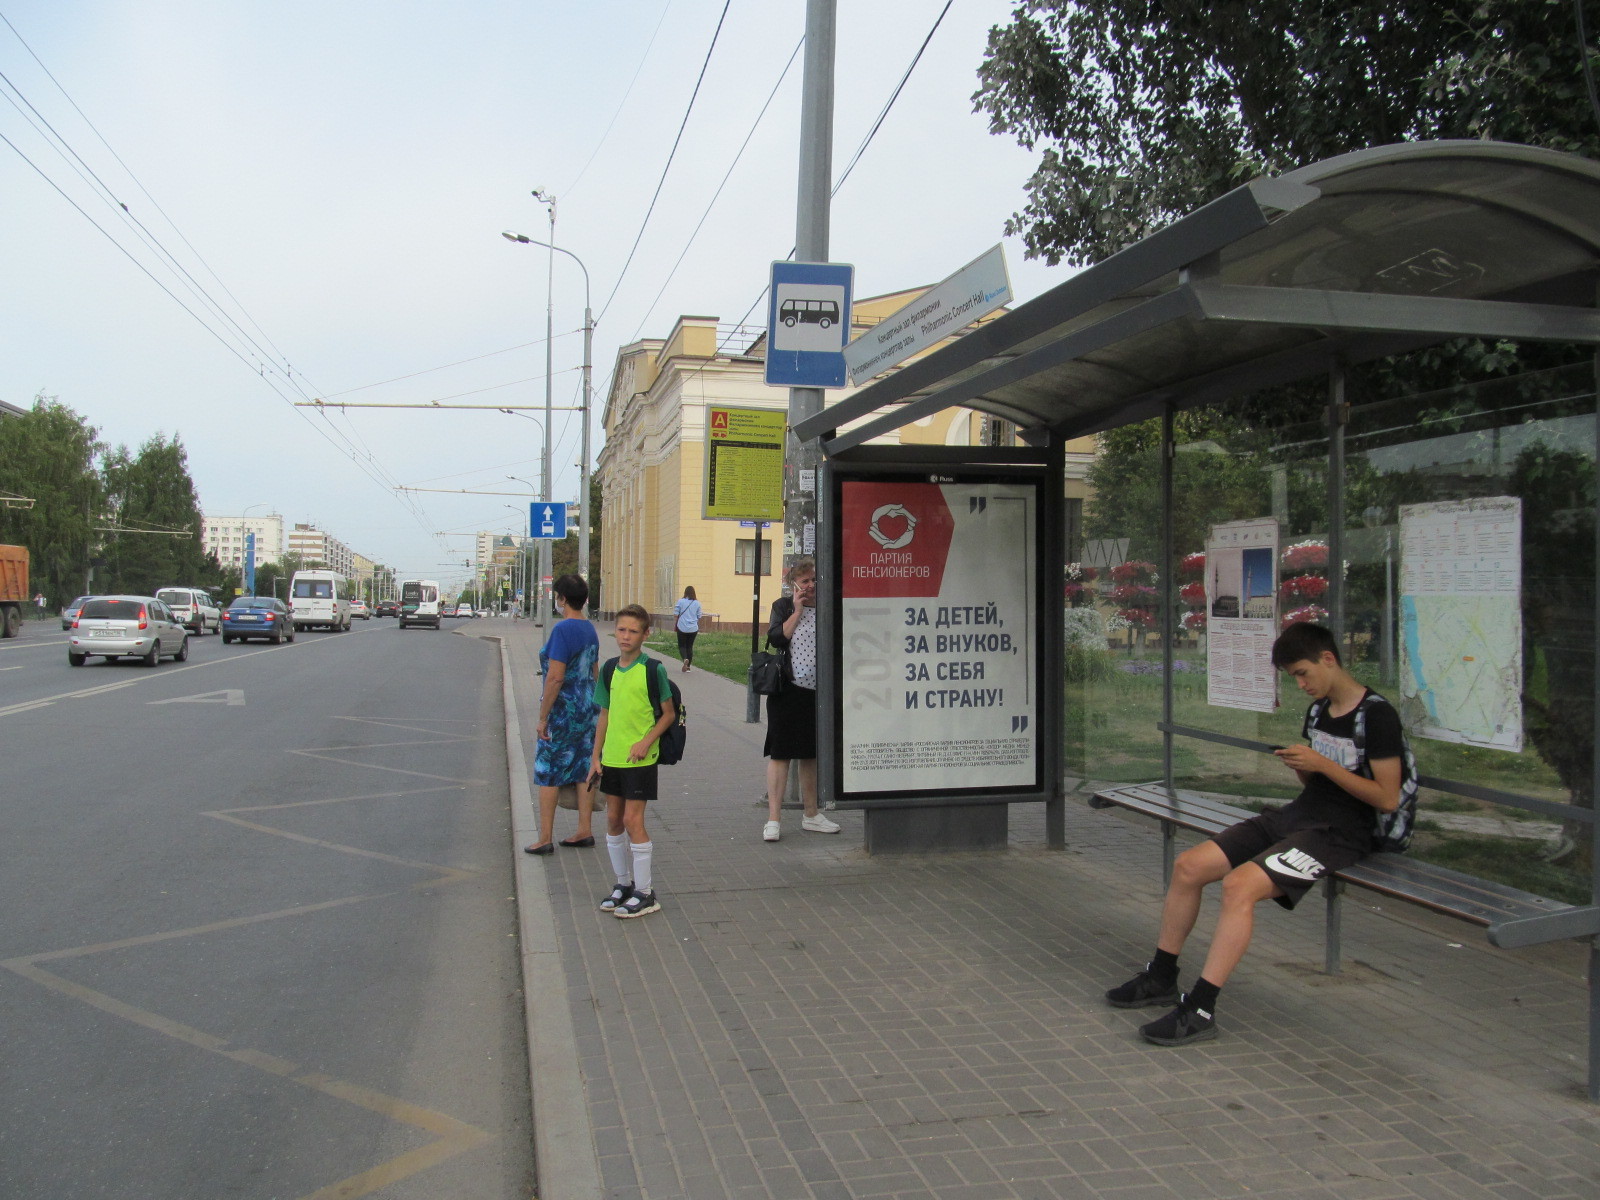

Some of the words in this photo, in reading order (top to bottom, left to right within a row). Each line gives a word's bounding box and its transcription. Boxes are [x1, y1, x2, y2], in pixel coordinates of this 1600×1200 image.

[902, 318, 911, 329] зал
[911, 299, 941, 326] филармонии
[921, 311, 952, 336] Philharmonic
[951, 298, 973, 318] Concert
[972, 290, 985, 306] Hall
[870, 552, 912, 564] ПАРТИЯ
[852, 566, 930, 578] ПЕНСИОНЕРОВ
[905, 607, 929, 626] ЗА
[936, 602, 1003, 628] ДЕТЕЙ,
[905, 635, 929, 653] ЗА
[937, 633, 1018, 655] ВНУКОВ,
[849, 607, 892, 711] 2021
[905, 663, 930, 682] ЗА
[937, 661, 985, 680] СЕБЯ
[905, 690, 918, 709] И
[925, 688, 1003, 709] СТРАНУ!
[1280, 847, 1326, 877] NIKE
